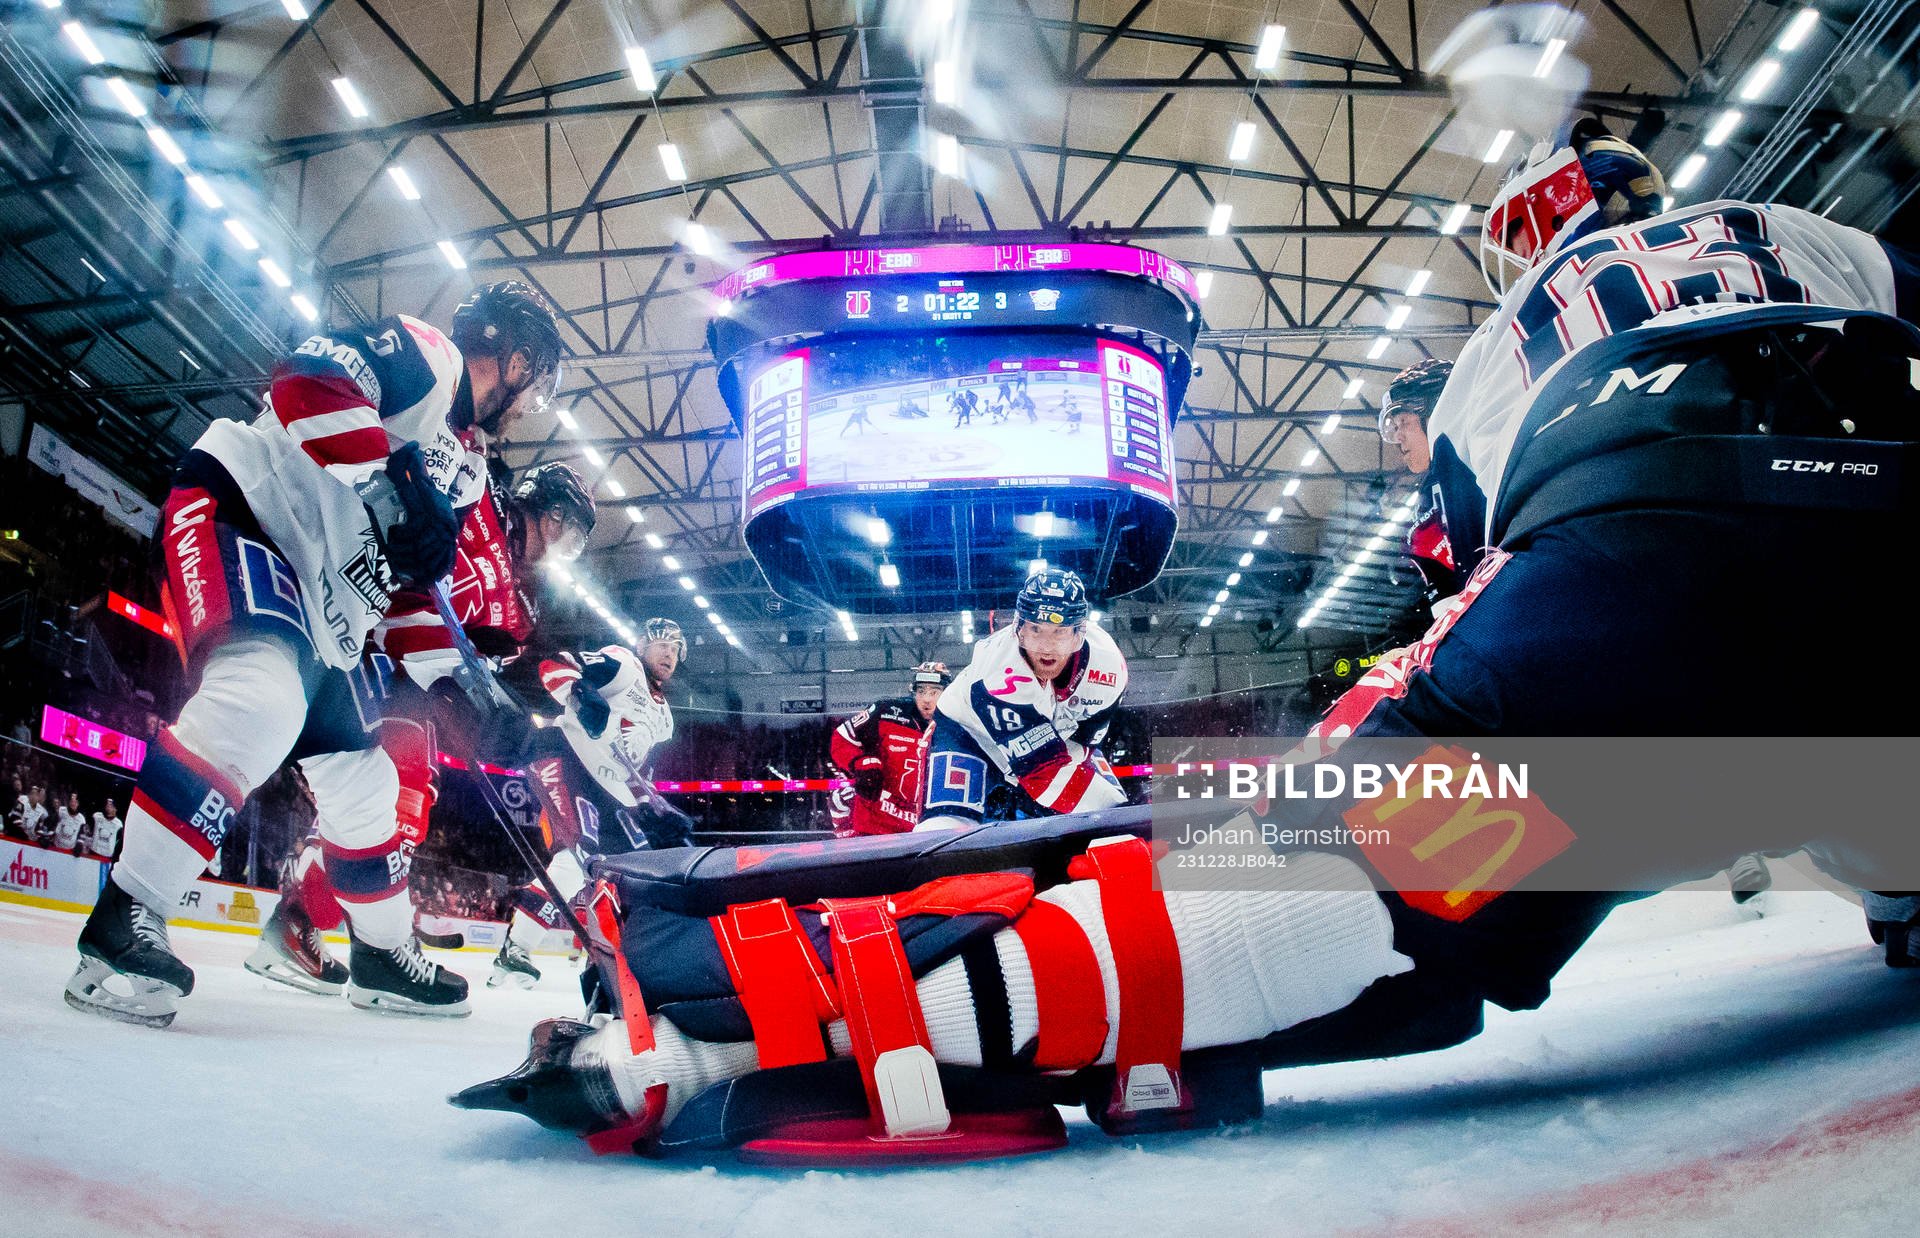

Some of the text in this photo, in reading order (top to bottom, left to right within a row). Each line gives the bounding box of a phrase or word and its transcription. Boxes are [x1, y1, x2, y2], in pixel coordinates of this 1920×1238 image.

[896, 295, 908, 313] 2
[924, 292, 979, 312] 01:22
[995, 292, 1006, 310] 3
[1771, 459, 1878, 475] CCM PRO
[358, 478, 379, 496] CCM
[490, 542, 512, 584] EXACT
[986, 705, 1024, 731] 19
[191, 812, 222, 846] BYGG
